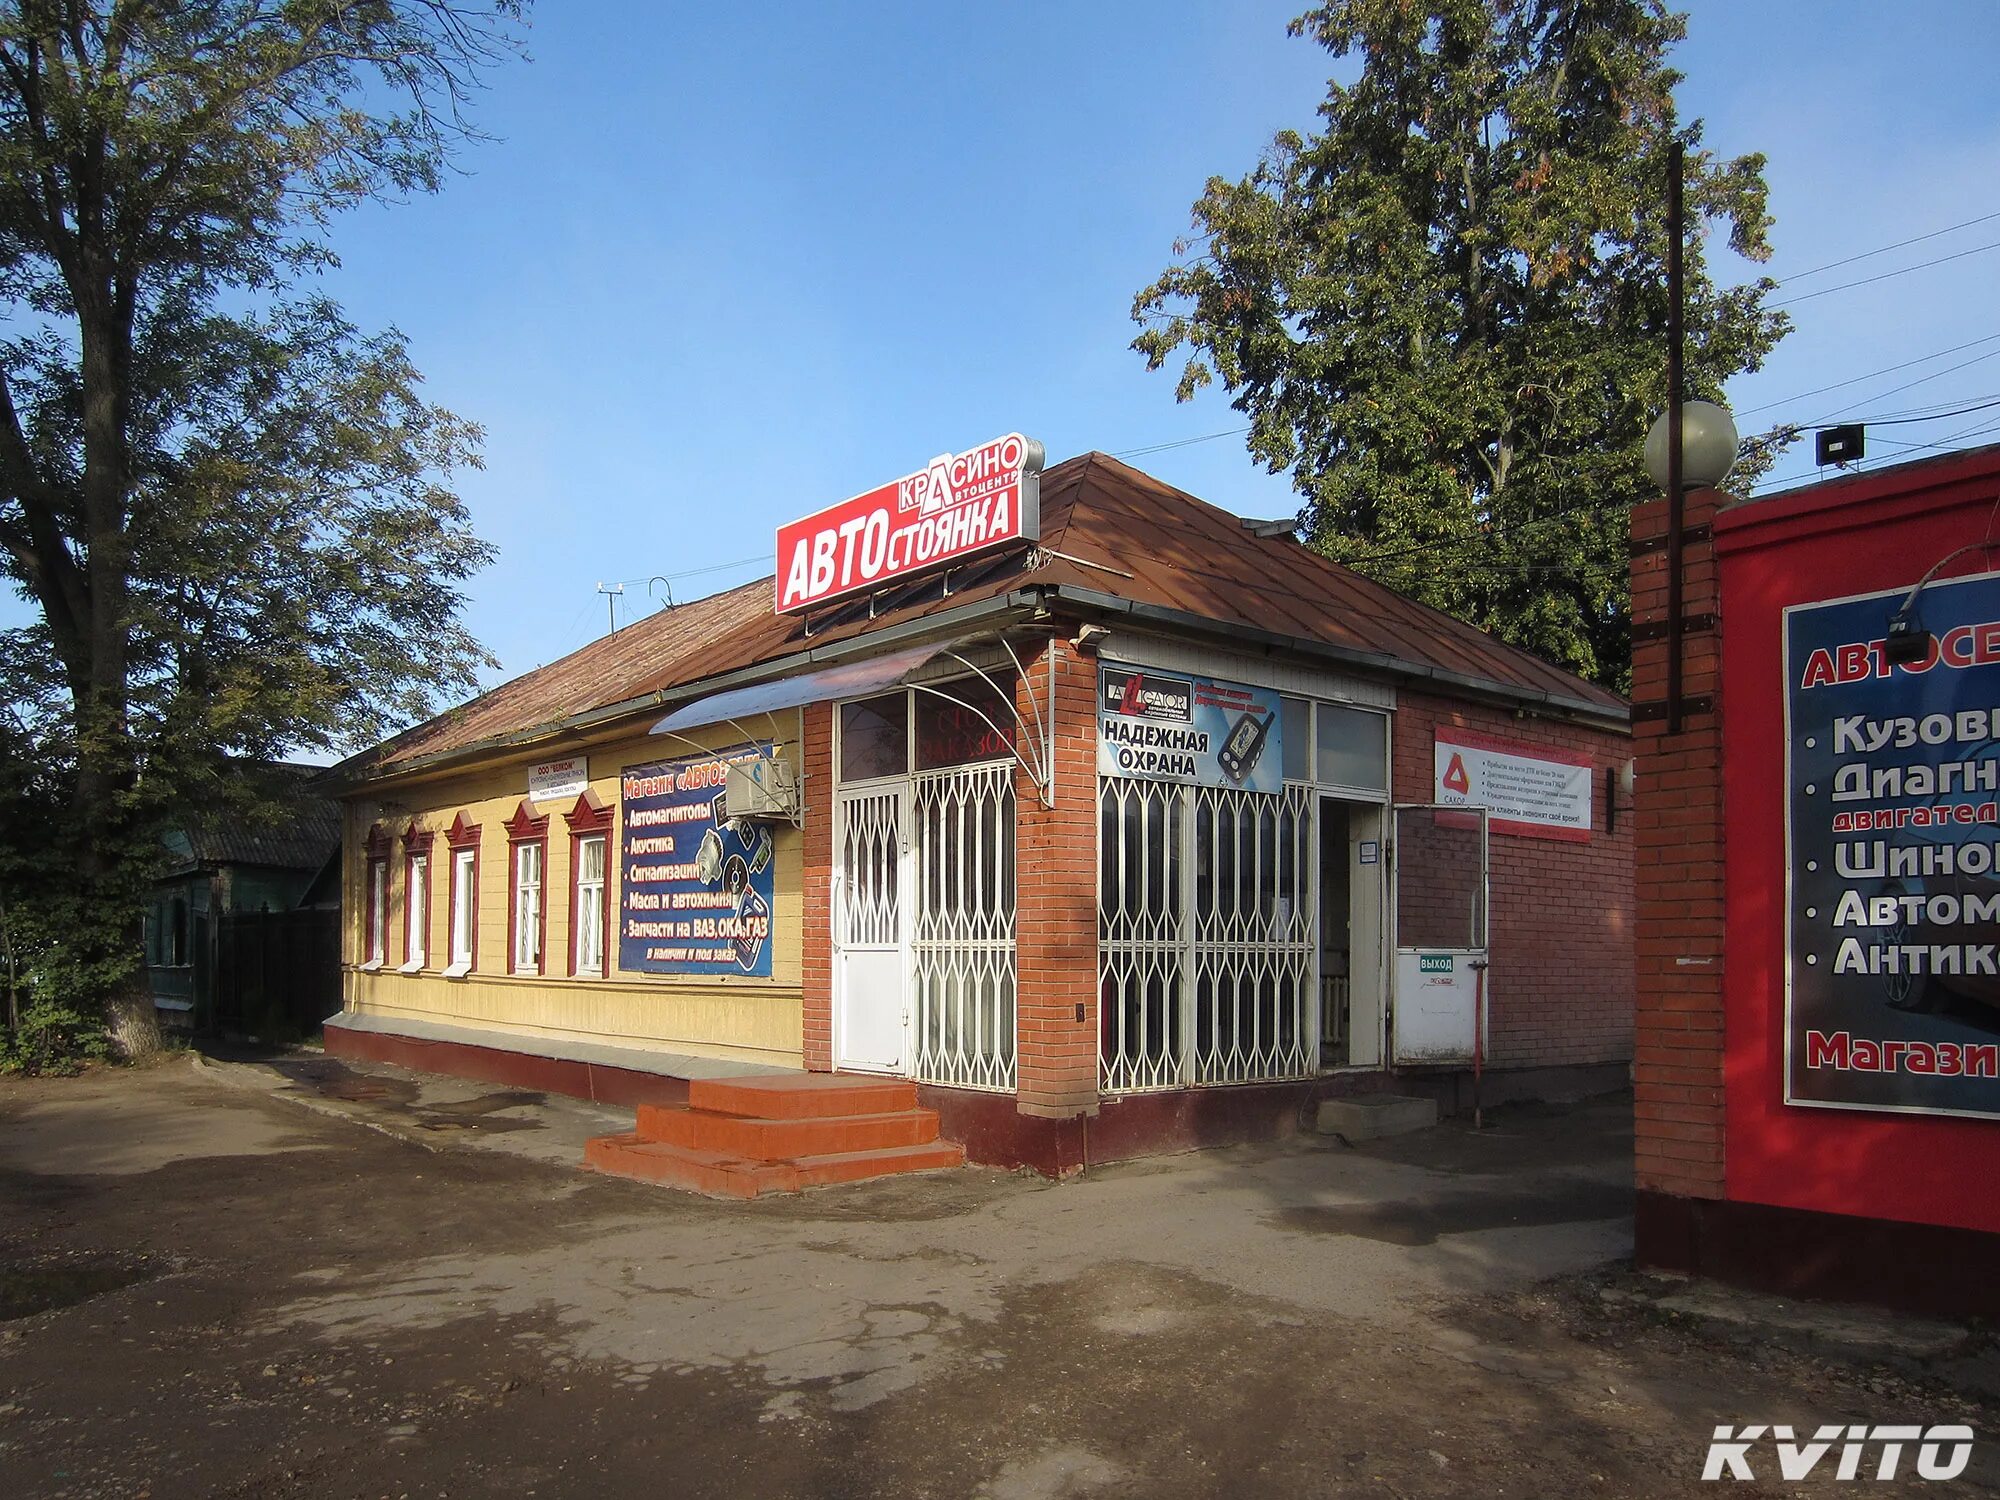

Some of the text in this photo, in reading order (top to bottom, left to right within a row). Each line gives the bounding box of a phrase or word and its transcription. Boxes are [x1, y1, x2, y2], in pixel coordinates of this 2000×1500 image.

[900, 437, 1023, 517] КРАСИНО
[1104, 720, 1209, 753] НАДЕЖНАЯ
[1118, 747, 1196, 776] ОХРАНА
[624, 774, 674, 800] Магазин
[630, 802, 711, 828] Автомагнитолы
[630, 836, 674, 855] Акустика
[1833, 840, 2000, 879] Шино
[630, 863, 701, 883] Сигнализации
[629, 891, 733, 910] Масла и автохимия
[628, 918, 674, 938] Запчасти
[676, 921, 691, 938] на
[687, 949, 694, 960] и
[695, 949, 712, 961] под
[713, 949, 737, 961] заказ
[1421, 959, 1452, 971] ВЫХОД
[1833, 937, 2000, 975] Антик
